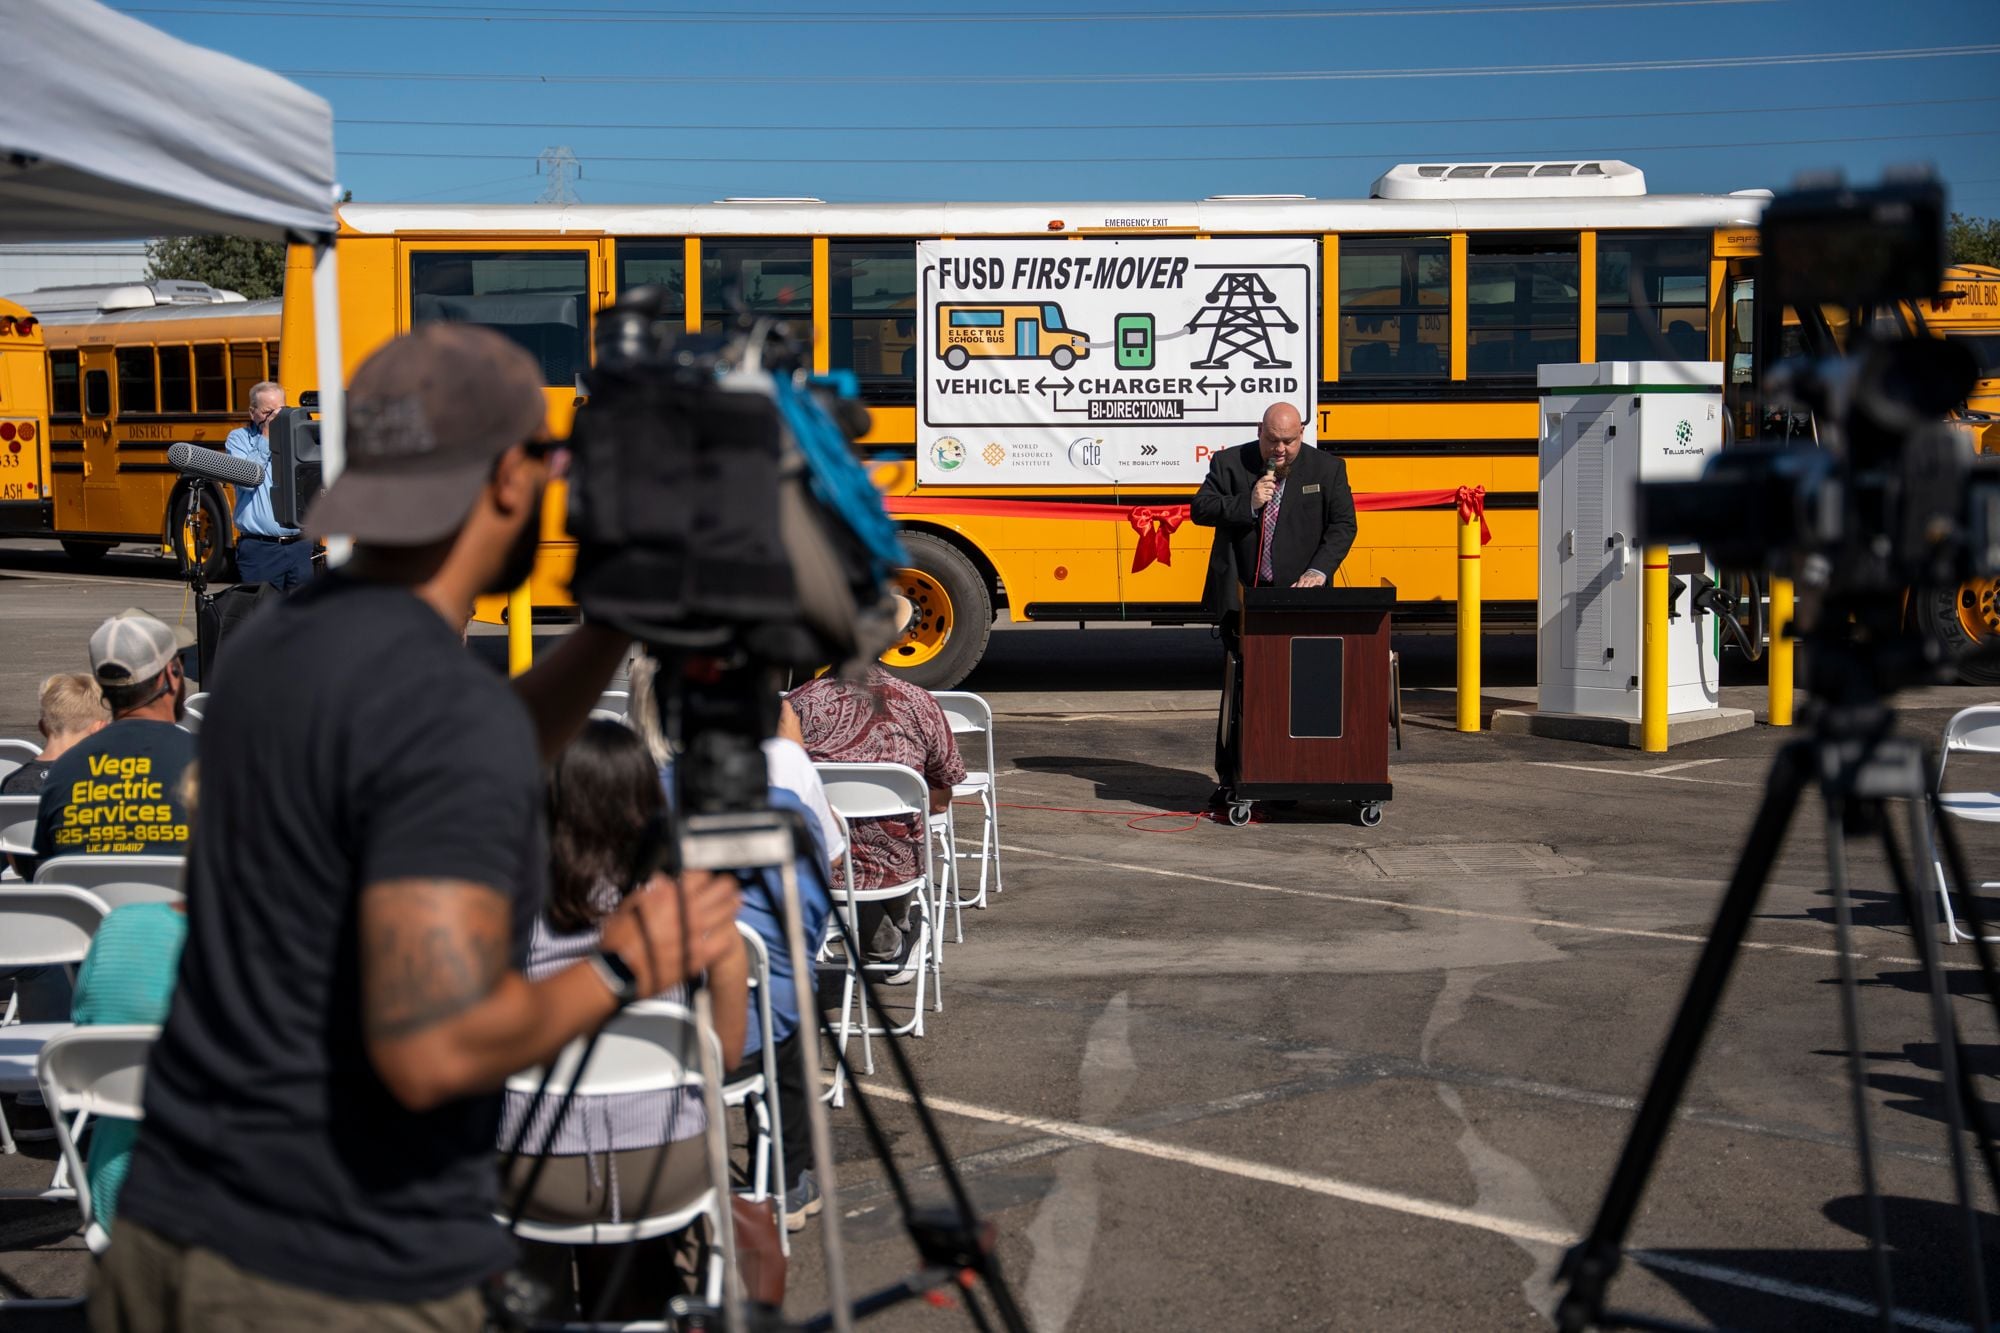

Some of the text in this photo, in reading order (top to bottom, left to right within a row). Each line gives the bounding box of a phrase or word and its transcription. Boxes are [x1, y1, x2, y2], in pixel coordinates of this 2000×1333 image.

[1105, 218, 1168, 227] EMERGENCY EXIT
[939, 256, 1189, 290] FUSD FIRST-MOVER
[1984, 285, 1998, 306] BUS
[936, 377, 1298, 394] VEHICLE CHARGER GRID
[1091, 401, 1181, 418] BI-DIRECTIONAL
[129, 425, 174, 439] DISTRICT
[0, 454, 20, 468] 33
[0, 483, 23, 499] ASH
[88, 754, 152, 780] Vega
[72, 778, 163, 804] Electric
[63, 801, 172, 827] Services
